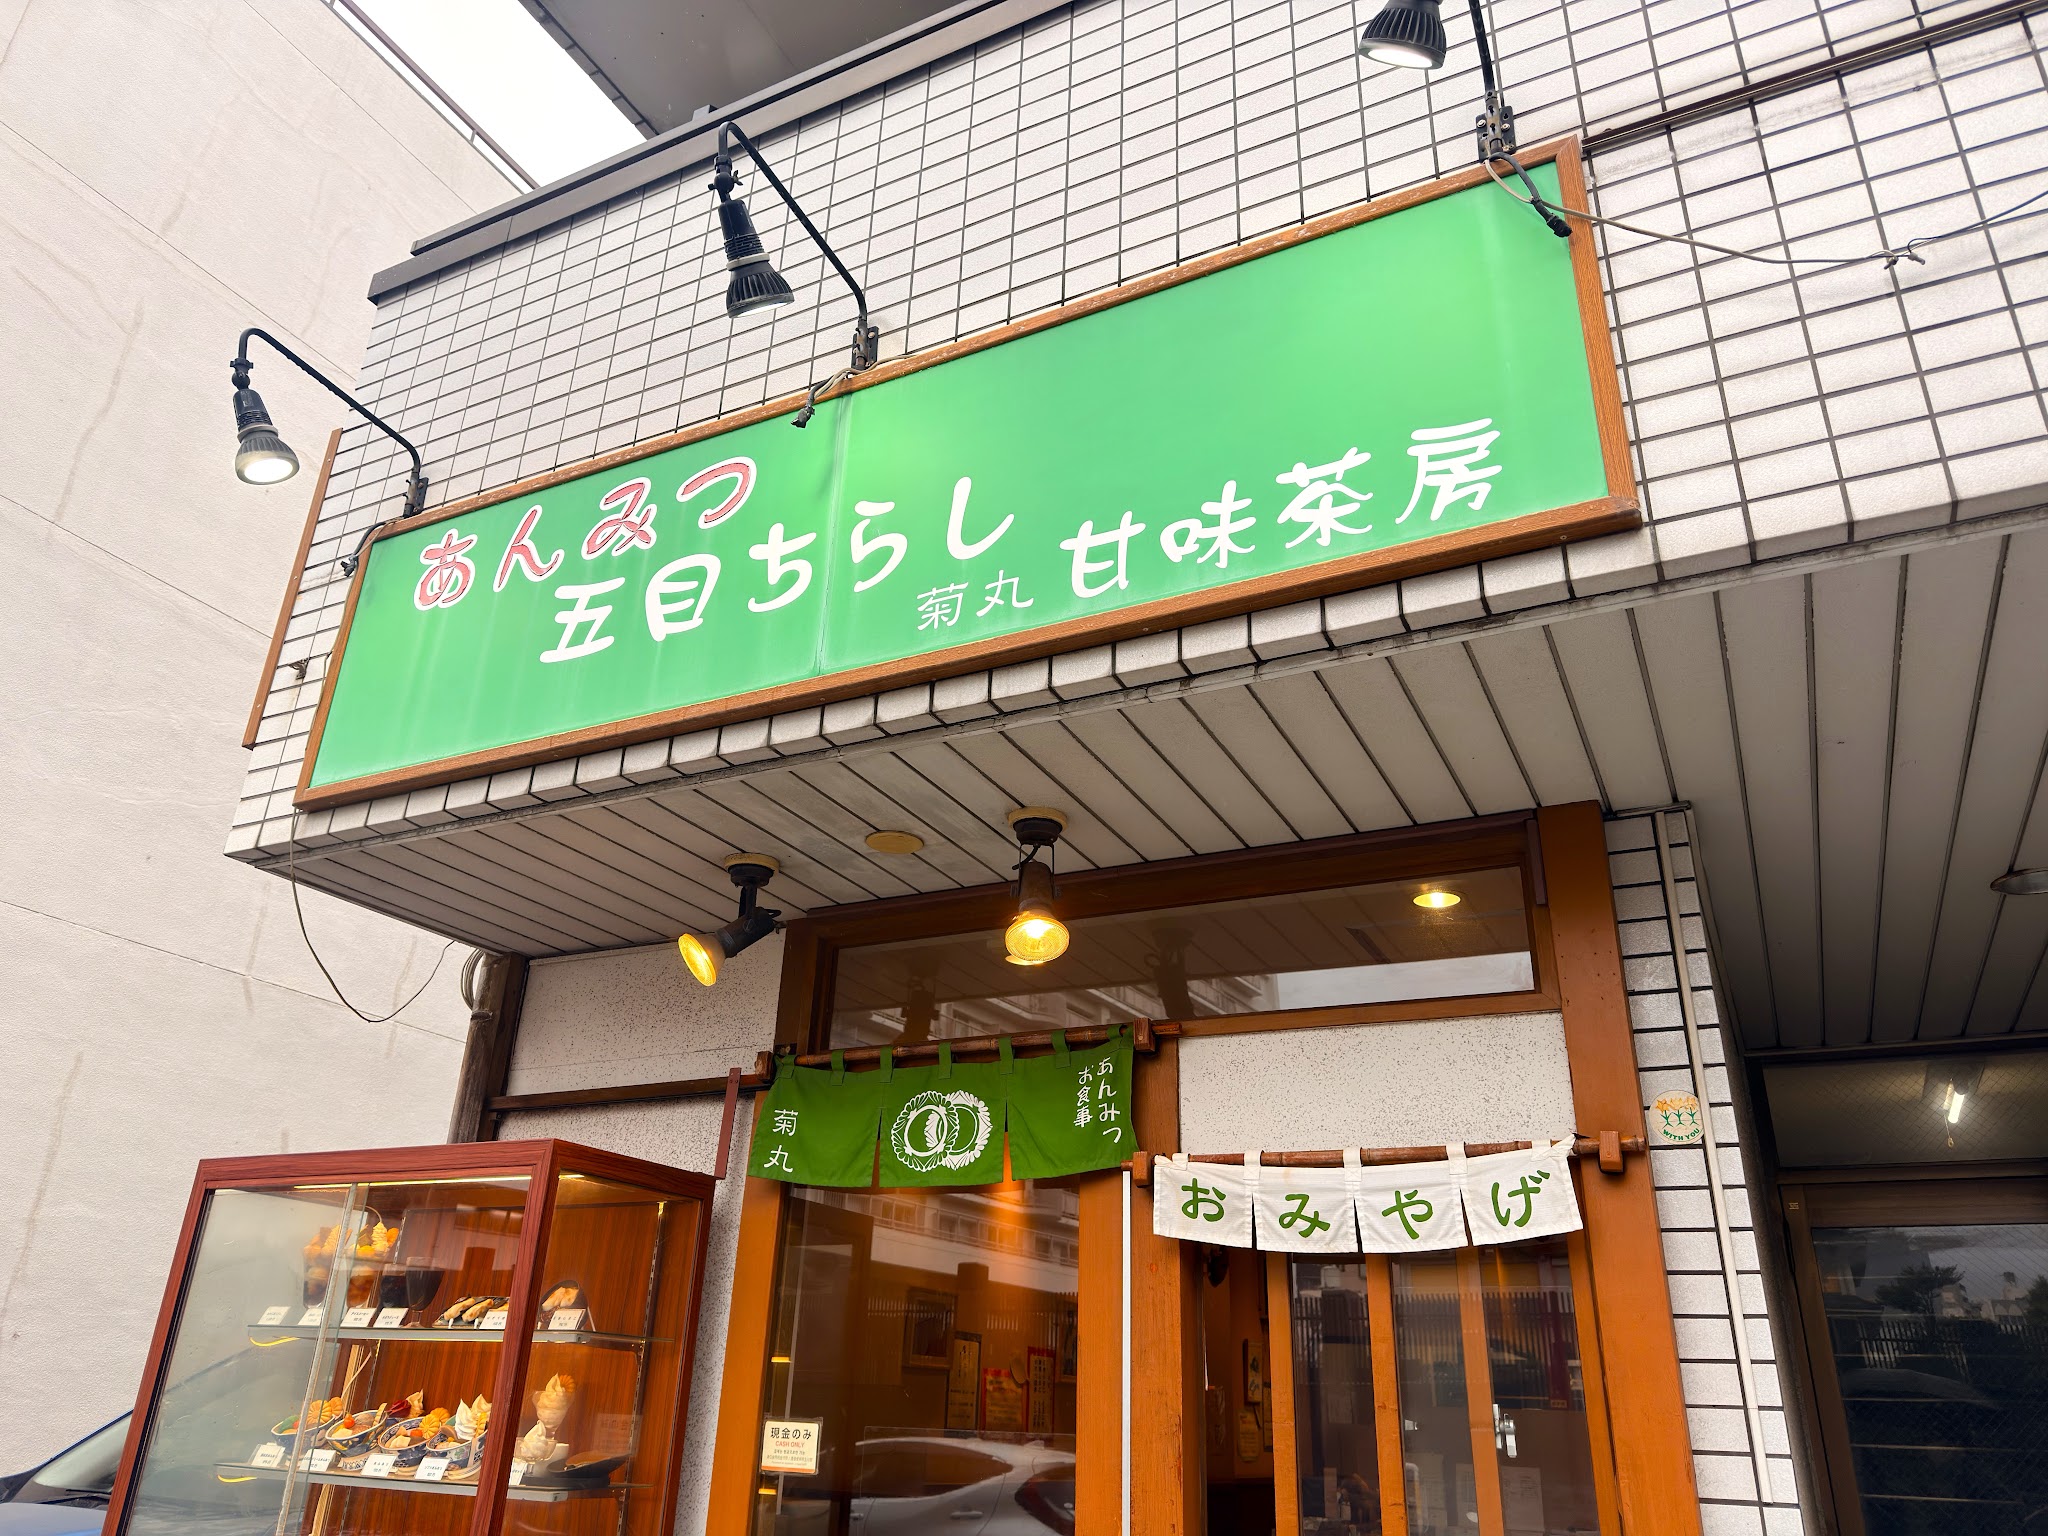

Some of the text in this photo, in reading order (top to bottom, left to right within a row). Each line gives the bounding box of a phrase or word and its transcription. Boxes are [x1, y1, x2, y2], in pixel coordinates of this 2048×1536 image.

[414, 456, 757, 610] あんみつ
[1059, 418, 1502, 599] 甘味茶房
[540, 477, 1014, 663] 五目ちらし
[917, 569, 1034, 631] 菊丸
[1073, 1064, 1093, 1127] お食事
[1097, 1057, 1122, 1143] あんみつ
[763, 1109, 798, 1172] 菊丸
[1663, 1128, 1700, 1141] WITH YOU
[1181, 1169, 1551, 1240] おみやげ
[771, 1427, 811, 1439] 現金のみ
[790, 1441, 805, 1449] ONLY
